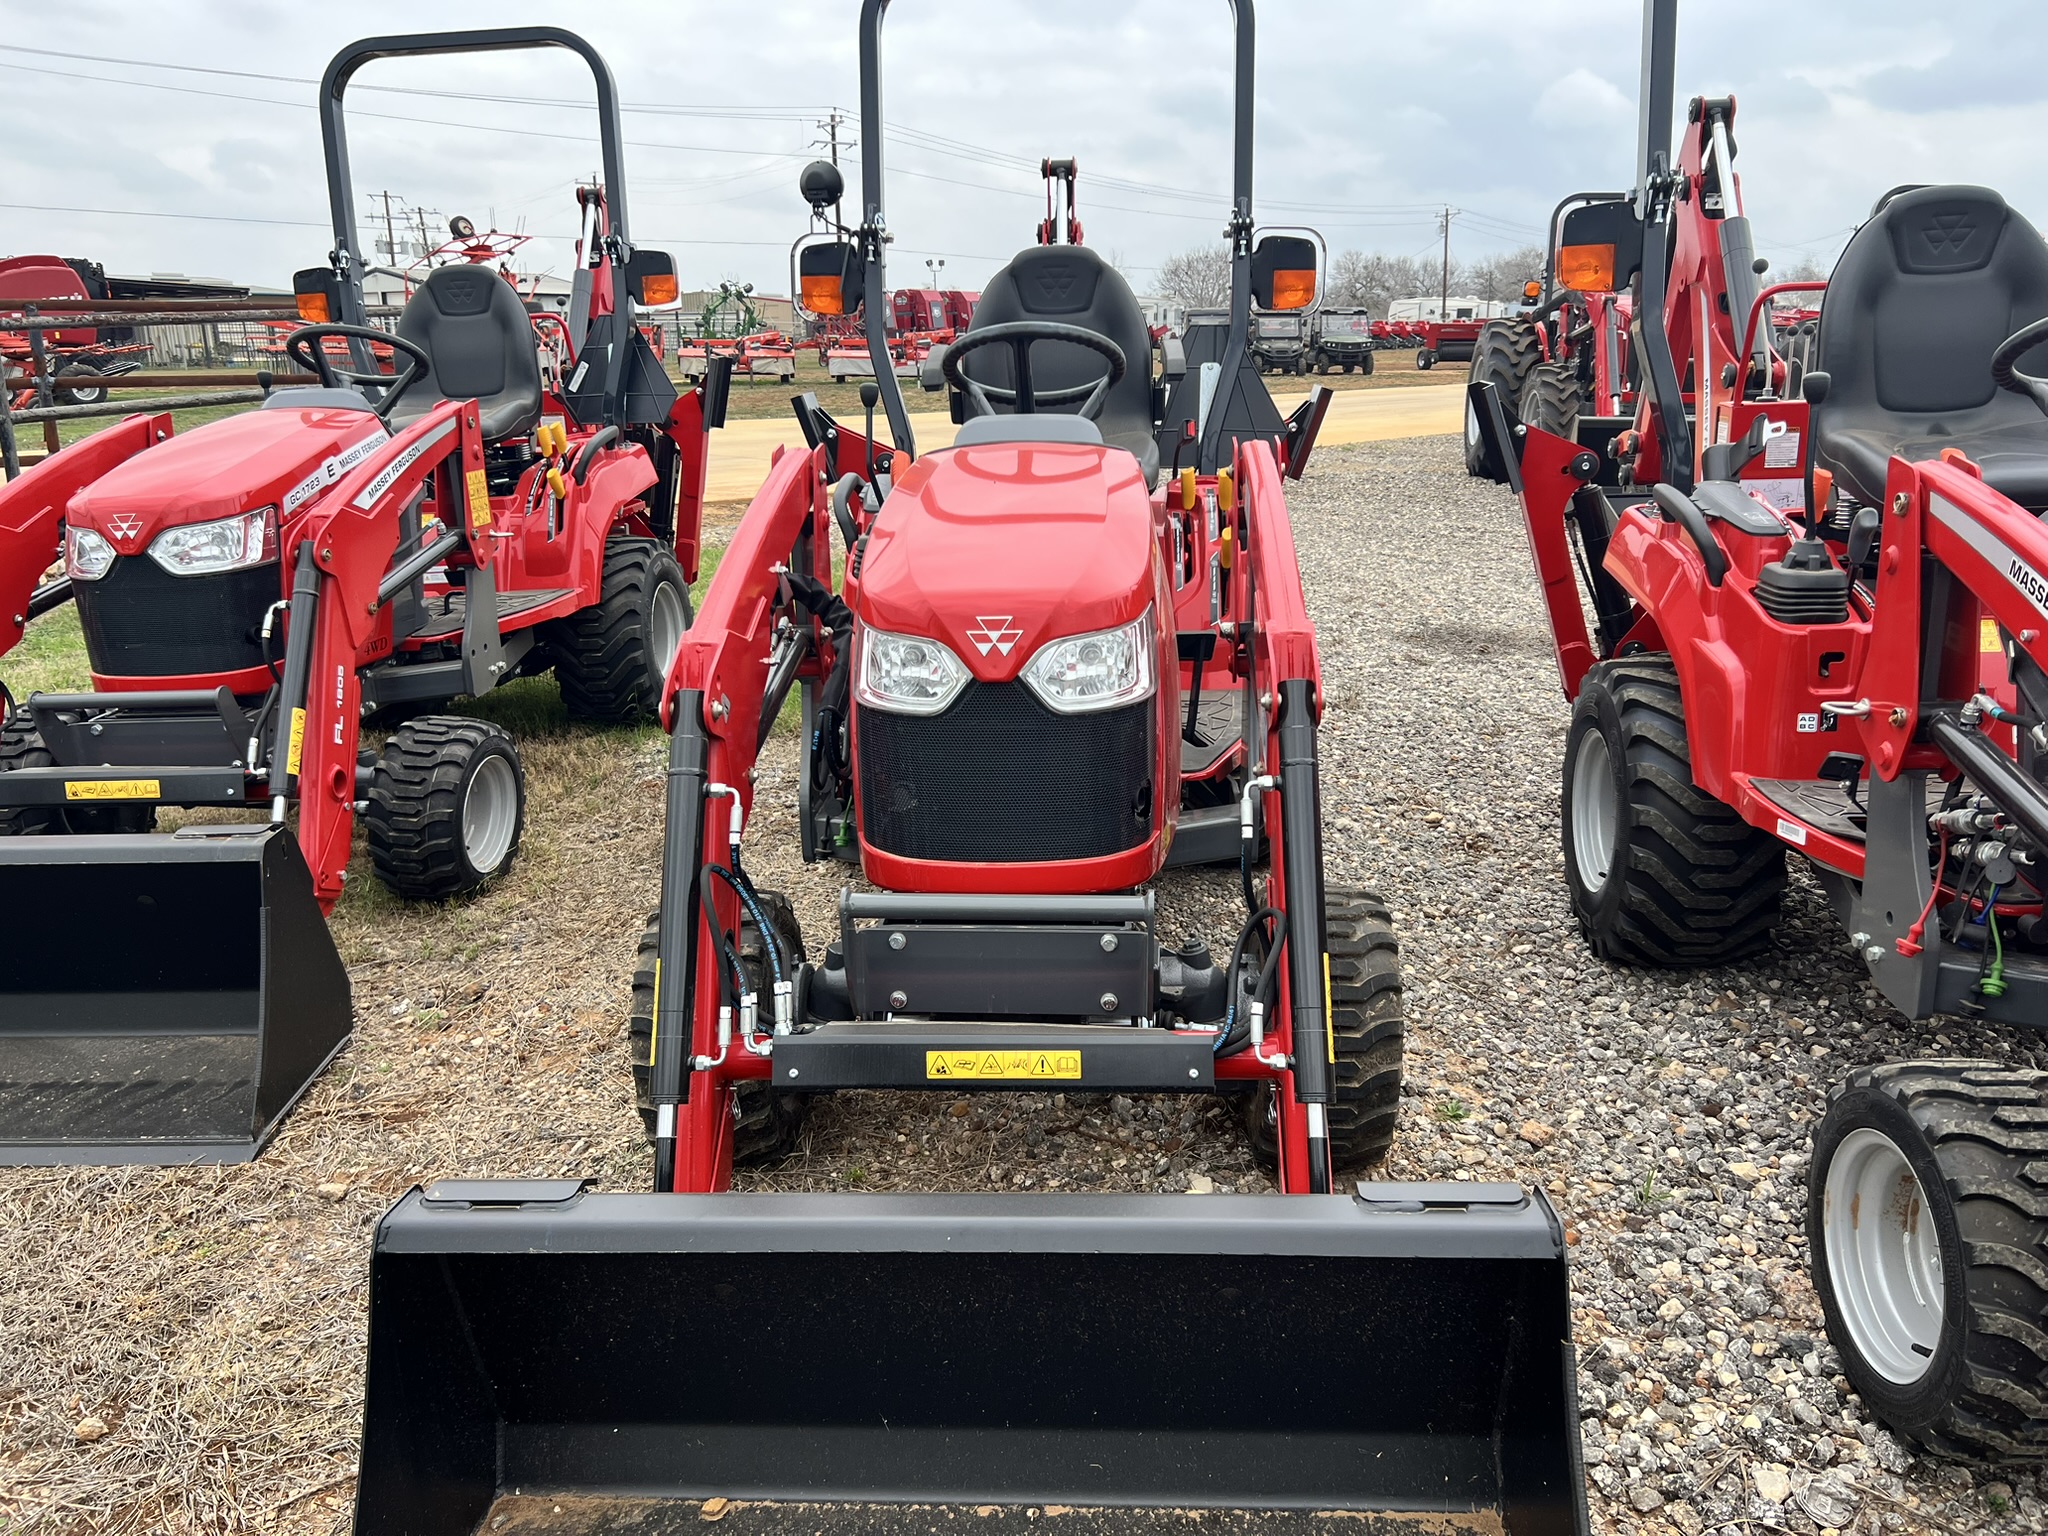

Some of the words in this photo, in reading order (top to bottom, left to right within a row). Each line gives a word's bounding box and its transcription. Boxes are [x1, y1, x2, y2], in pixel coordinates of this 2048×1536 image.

[326, 463, 336, 479] E
[339, 451, 361, 470] MASSEY
[360, 435, 387, 454] FERGUSON
[368, 472, 392, 500] MASSEY
[391, 444, 422, 476] FERGUSON
[364, 636, 388, 656] 4WD
[334, 715, 344, 745] FL
